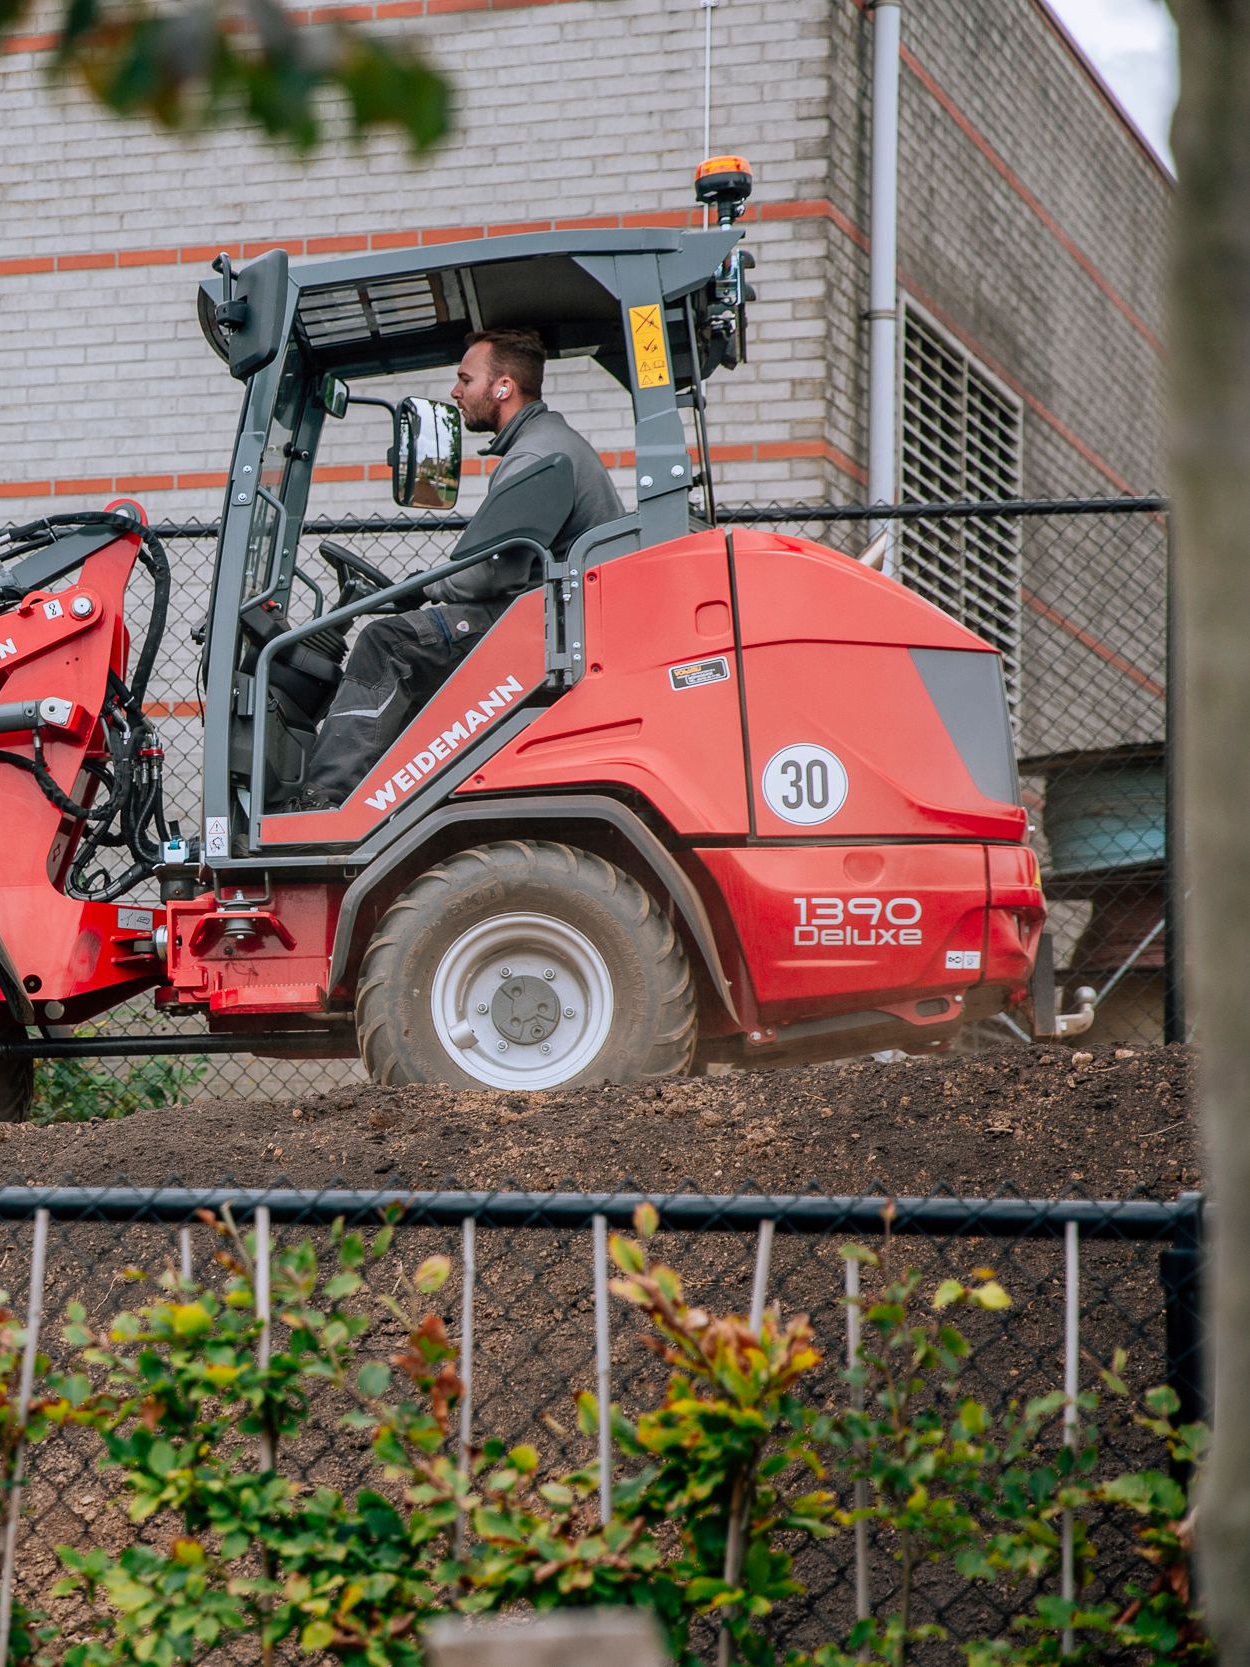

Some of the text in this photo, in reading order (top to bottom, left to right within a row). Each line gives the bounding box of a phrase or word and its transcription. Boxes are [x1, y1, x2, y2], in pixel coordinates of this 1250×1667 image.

[364, 674, 524, 811] WEIDEMANN
[781, 759, 829, 809] 30
[793, 898, 922, 925] 1390
[793, 926, 922, 945] Deluxe
